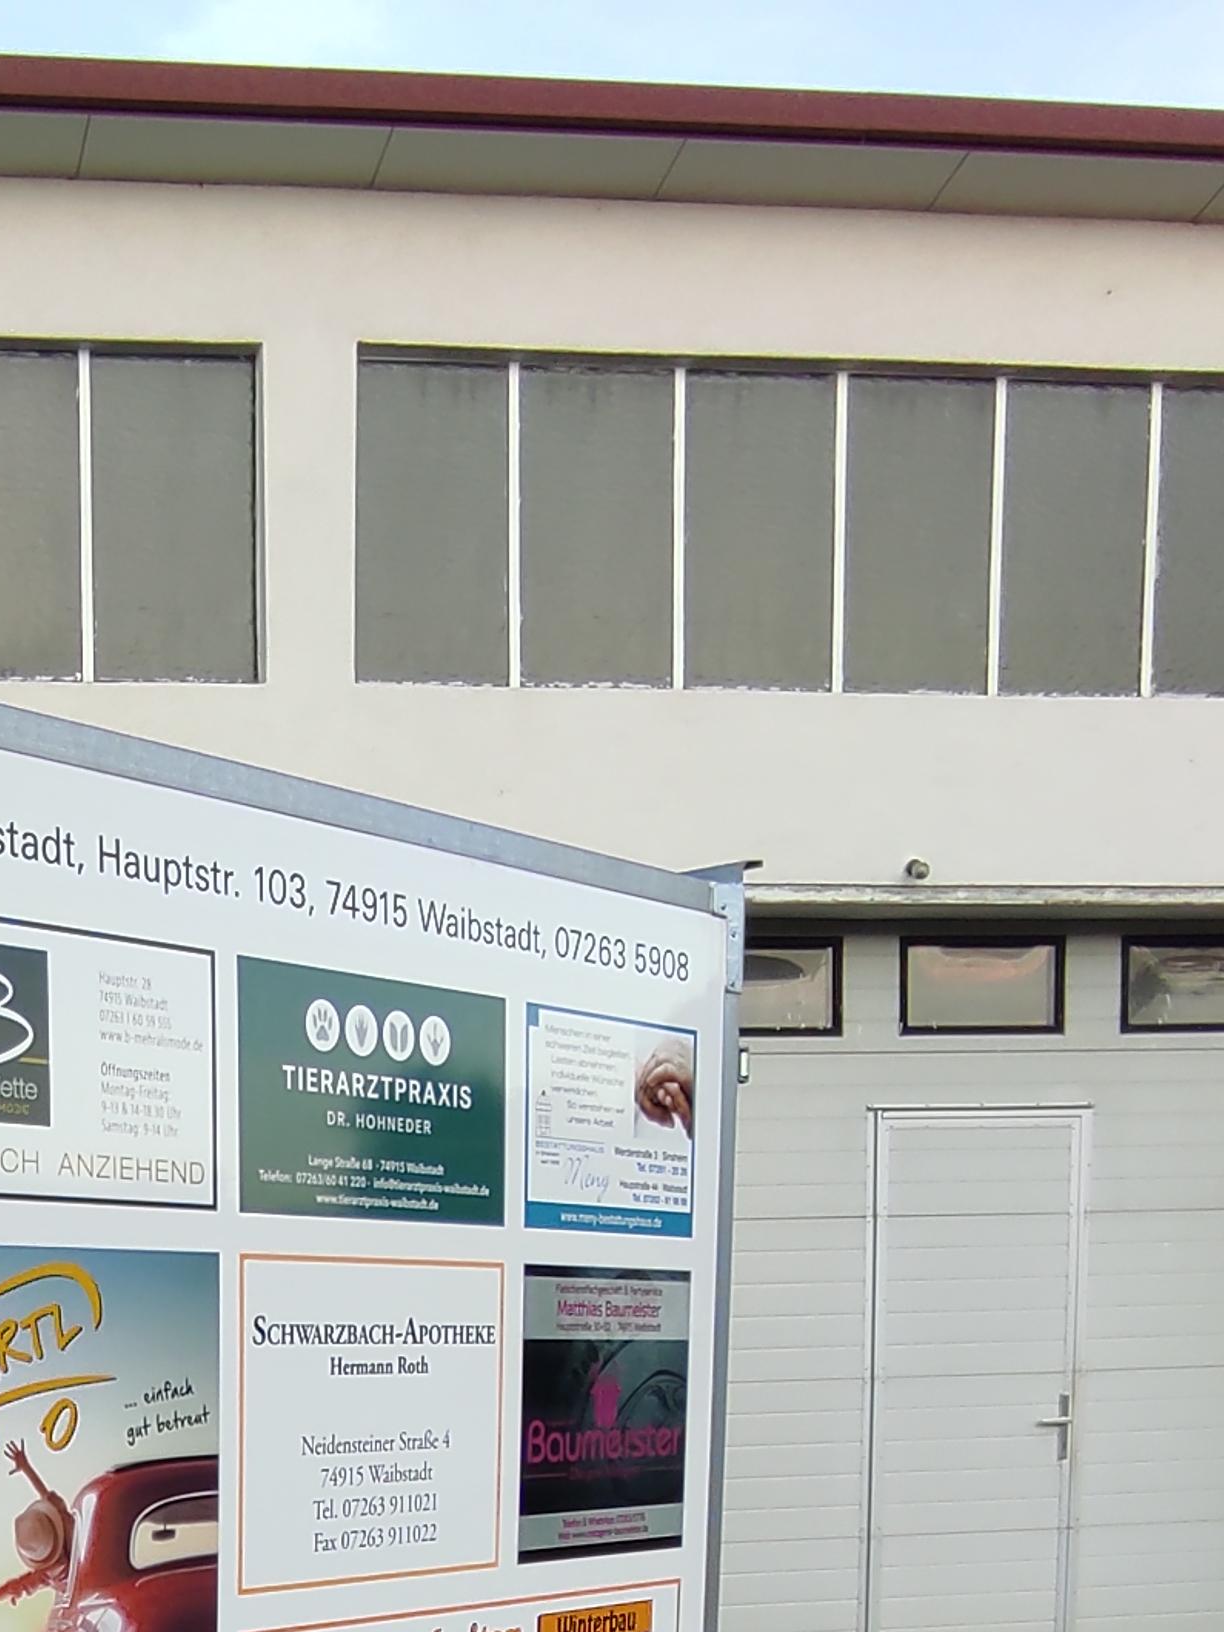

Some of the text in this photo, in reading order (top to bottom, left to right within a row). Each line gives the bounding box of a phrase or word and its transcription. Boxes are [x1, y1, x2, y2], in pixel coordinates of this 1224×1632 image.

[98, 835, 240, 897] Hauptstr.
[254, 866, 314, 916] 103,
[327, 880, 408, 927] 74915
[418, 899, 546, 959] Waibstadt,
[555, 926, 626, 968] 07263
[635, 944, 690, 981] 5908
[282, 1064, 472, 1110] TIERARZTPRAXIS
[327, 1111, 432, 1135] DR. HOHNEDER
[58, 1153, 205, 1185] ANZIEHEND
[259, 1169, 292, 1183] Telefon:
[308, 1155, 404, 1173] Lange Straße 74915
[329, 1356, 429, 1377] Hermann Roth
[143, 1379, 195, 1406] einfach
[125, 1421, 152, 1446] gut
[301, 1430, 450, 1457] Neidensteiner Straße 4
[528, 1419, 682, 1463] Baumeister
[320, 1460, 433, 1487] 74915 Waibstadt
[312, 1492, 437, 1520] Tel. 07263 911021
[313, 1523, 437, 1553] Fax 07263 911022
